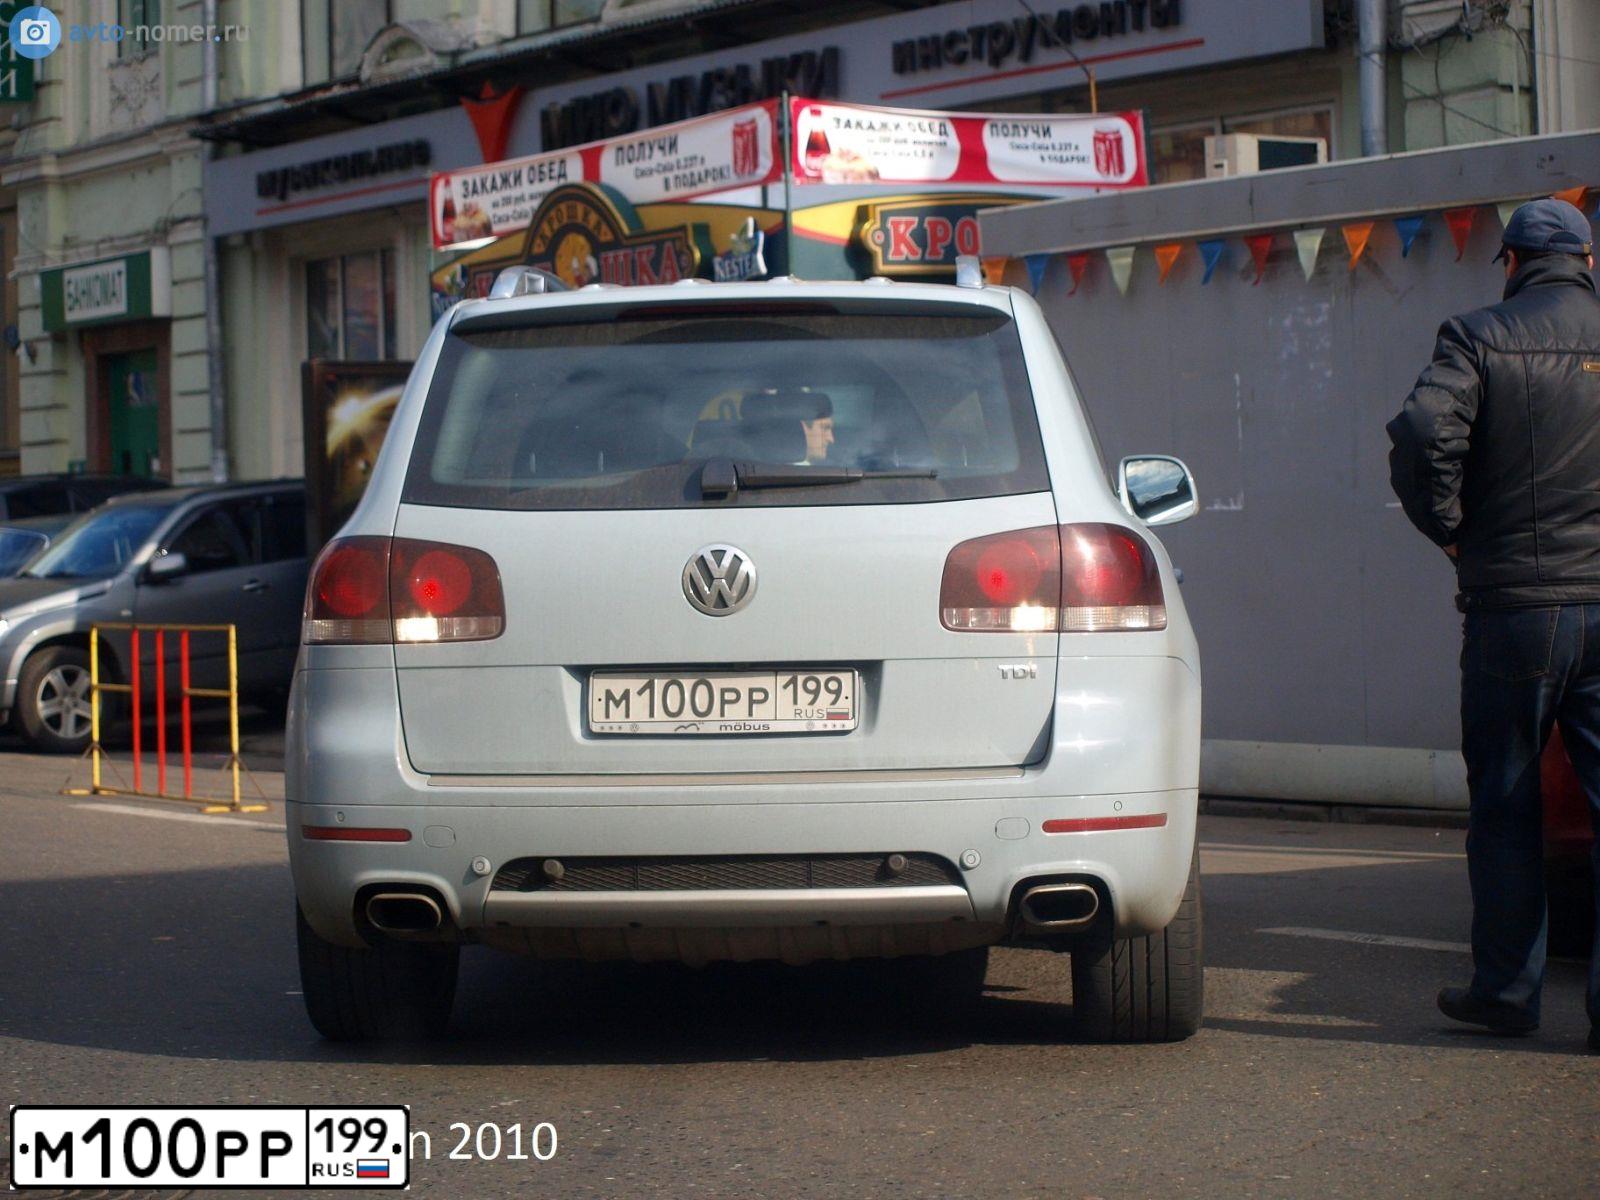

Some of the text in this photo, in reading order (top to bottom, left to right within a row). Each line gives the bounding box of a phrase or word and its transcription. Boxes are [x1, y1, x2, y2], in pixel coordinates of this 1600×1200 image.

[989, 122, 1053, 138] ПОЛУЧИ
[615, 134, 679, 166] ПОЛУЧИ
[462, 160, 568, 199] ЗАКАЖИ ОБЕД
[674, 163, 731, 188] ПОДАРОК!
[67, 269, 123, 312] БАНКОМАТ
[782, 674, 843, 706] 199
[719, 721, 771, 731] möbus
[794, 708, 825, 719] RUS
